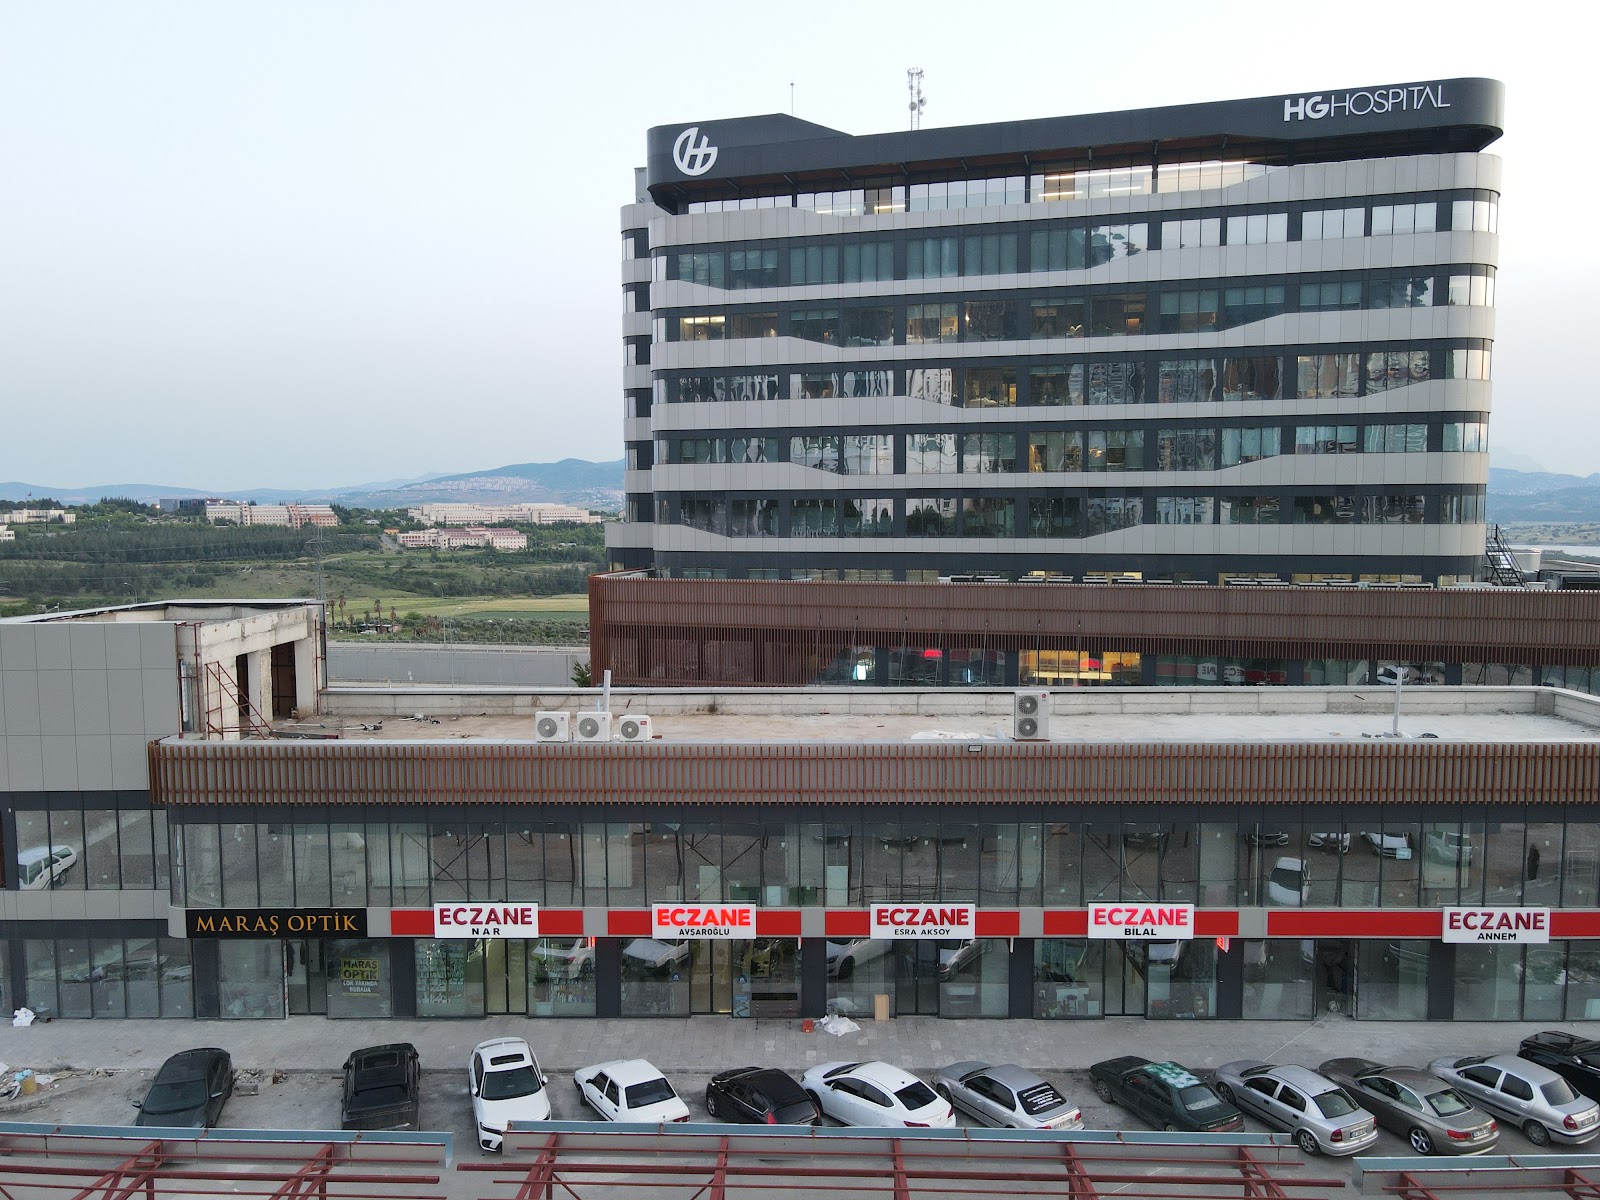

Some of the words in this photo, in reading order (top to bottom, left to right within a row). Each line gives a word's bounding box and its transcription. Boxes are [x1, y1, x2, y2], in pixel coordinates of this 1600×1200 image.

[196, 915, 280, 936] MARAŞ
[287, 912, 359, 932] OPTİK
[439, 907, 533, 925] ECZANE
[657, 908, 751, 926] ECZANE
[877, 908, 969, 926] ECZANE
[1094, 908, 1188, 926] ECZANE
[1449, 911, 1545, 930] ECZANE
[471, 928, 501, 936] NAR
[678, 927, 730, 937] AVŞAROĞLU
[894, 928, 917, 936] ESRA
[921, 928, 951, 936] AKSOY
[1124, 926, 1157, 936] BİLAL
[1477, 932, 1517, 941] ANNEM
